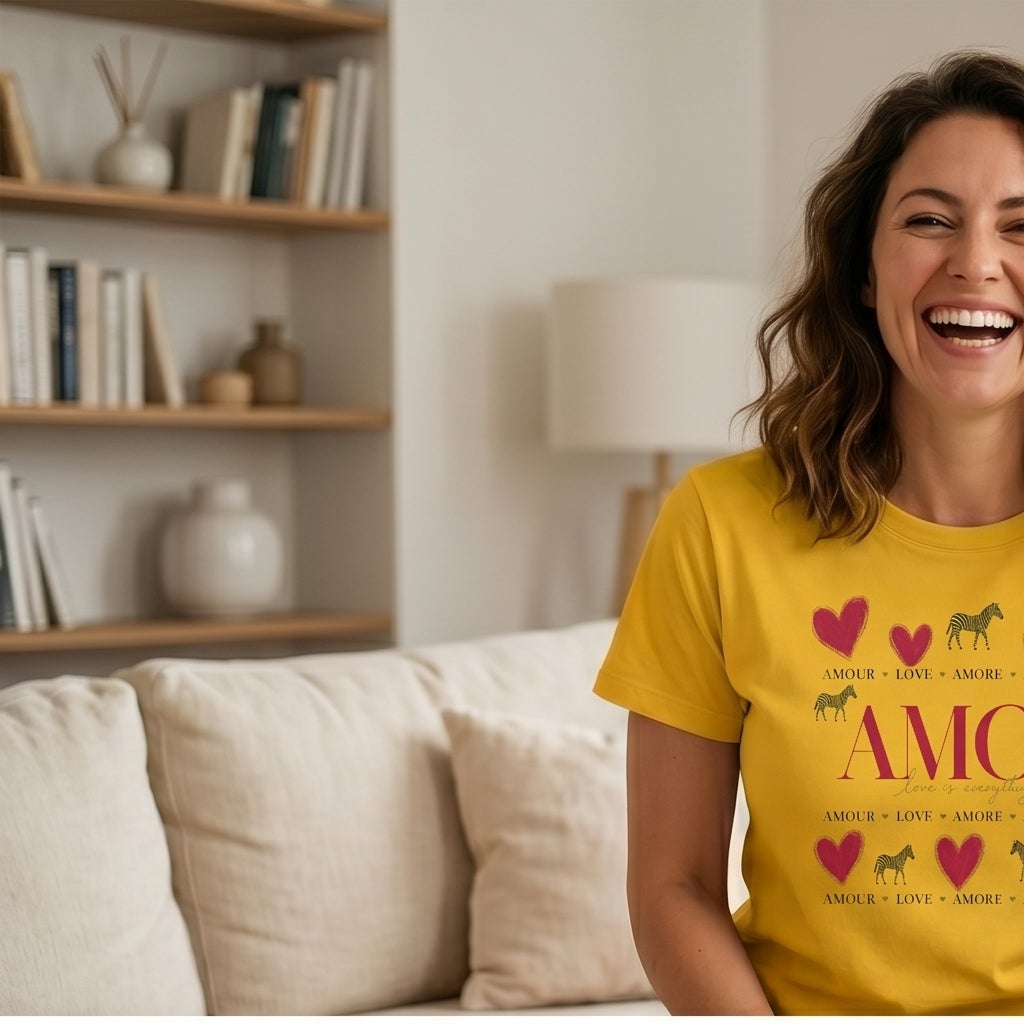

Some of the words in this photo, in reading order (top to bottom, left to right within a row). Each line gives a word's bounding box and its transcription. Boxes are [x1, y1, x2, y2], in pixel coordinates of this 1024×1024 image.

[822, 668, 876, 680] AMOUR
[895, 668, 933, 680] LOVE
[952, 668, 1003, 680] AMORE
[893, 767, 937, 797] love
[942, 782, 956, 795] is
[822, 810, 876, 822] AMOUR
[895, 810, 933, 822] LOVE
[952, 810, 1003, 822] AMORE
[822, 893, 876, 905] AMOUR
[895, 893, 933, 905] LOVE
[952, 893, 1003, 905] AMORE
